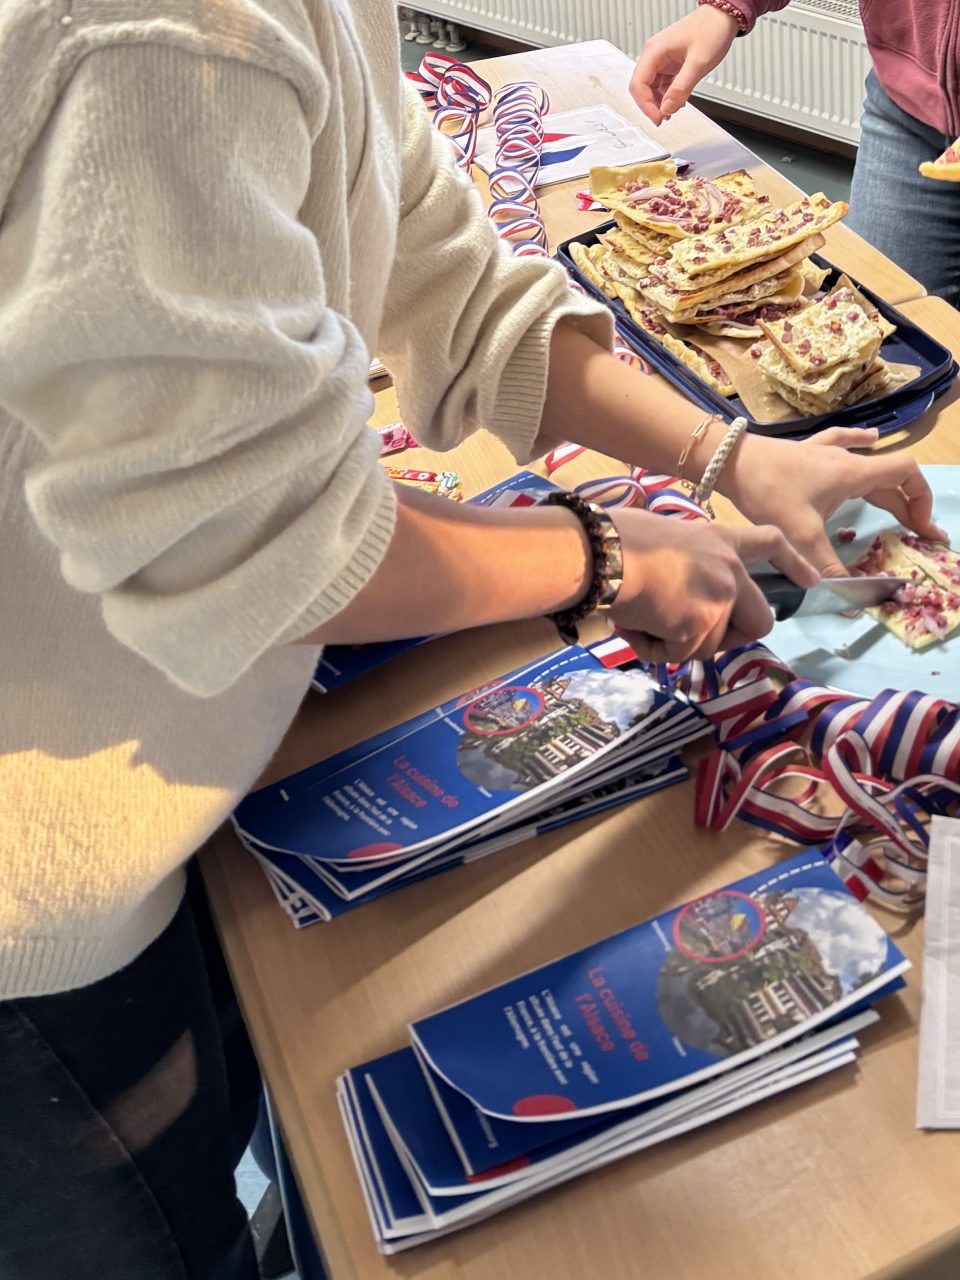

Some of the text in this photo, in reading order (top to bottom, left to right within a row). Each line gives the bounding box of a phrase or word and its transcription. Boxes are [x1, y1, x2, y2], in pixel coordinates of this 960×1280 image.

[393, 755, 410, 769] La
[441, 795, 460, 808] de
[587, 966, 606, 987] La
[629, 1041, 648, 1062] de
